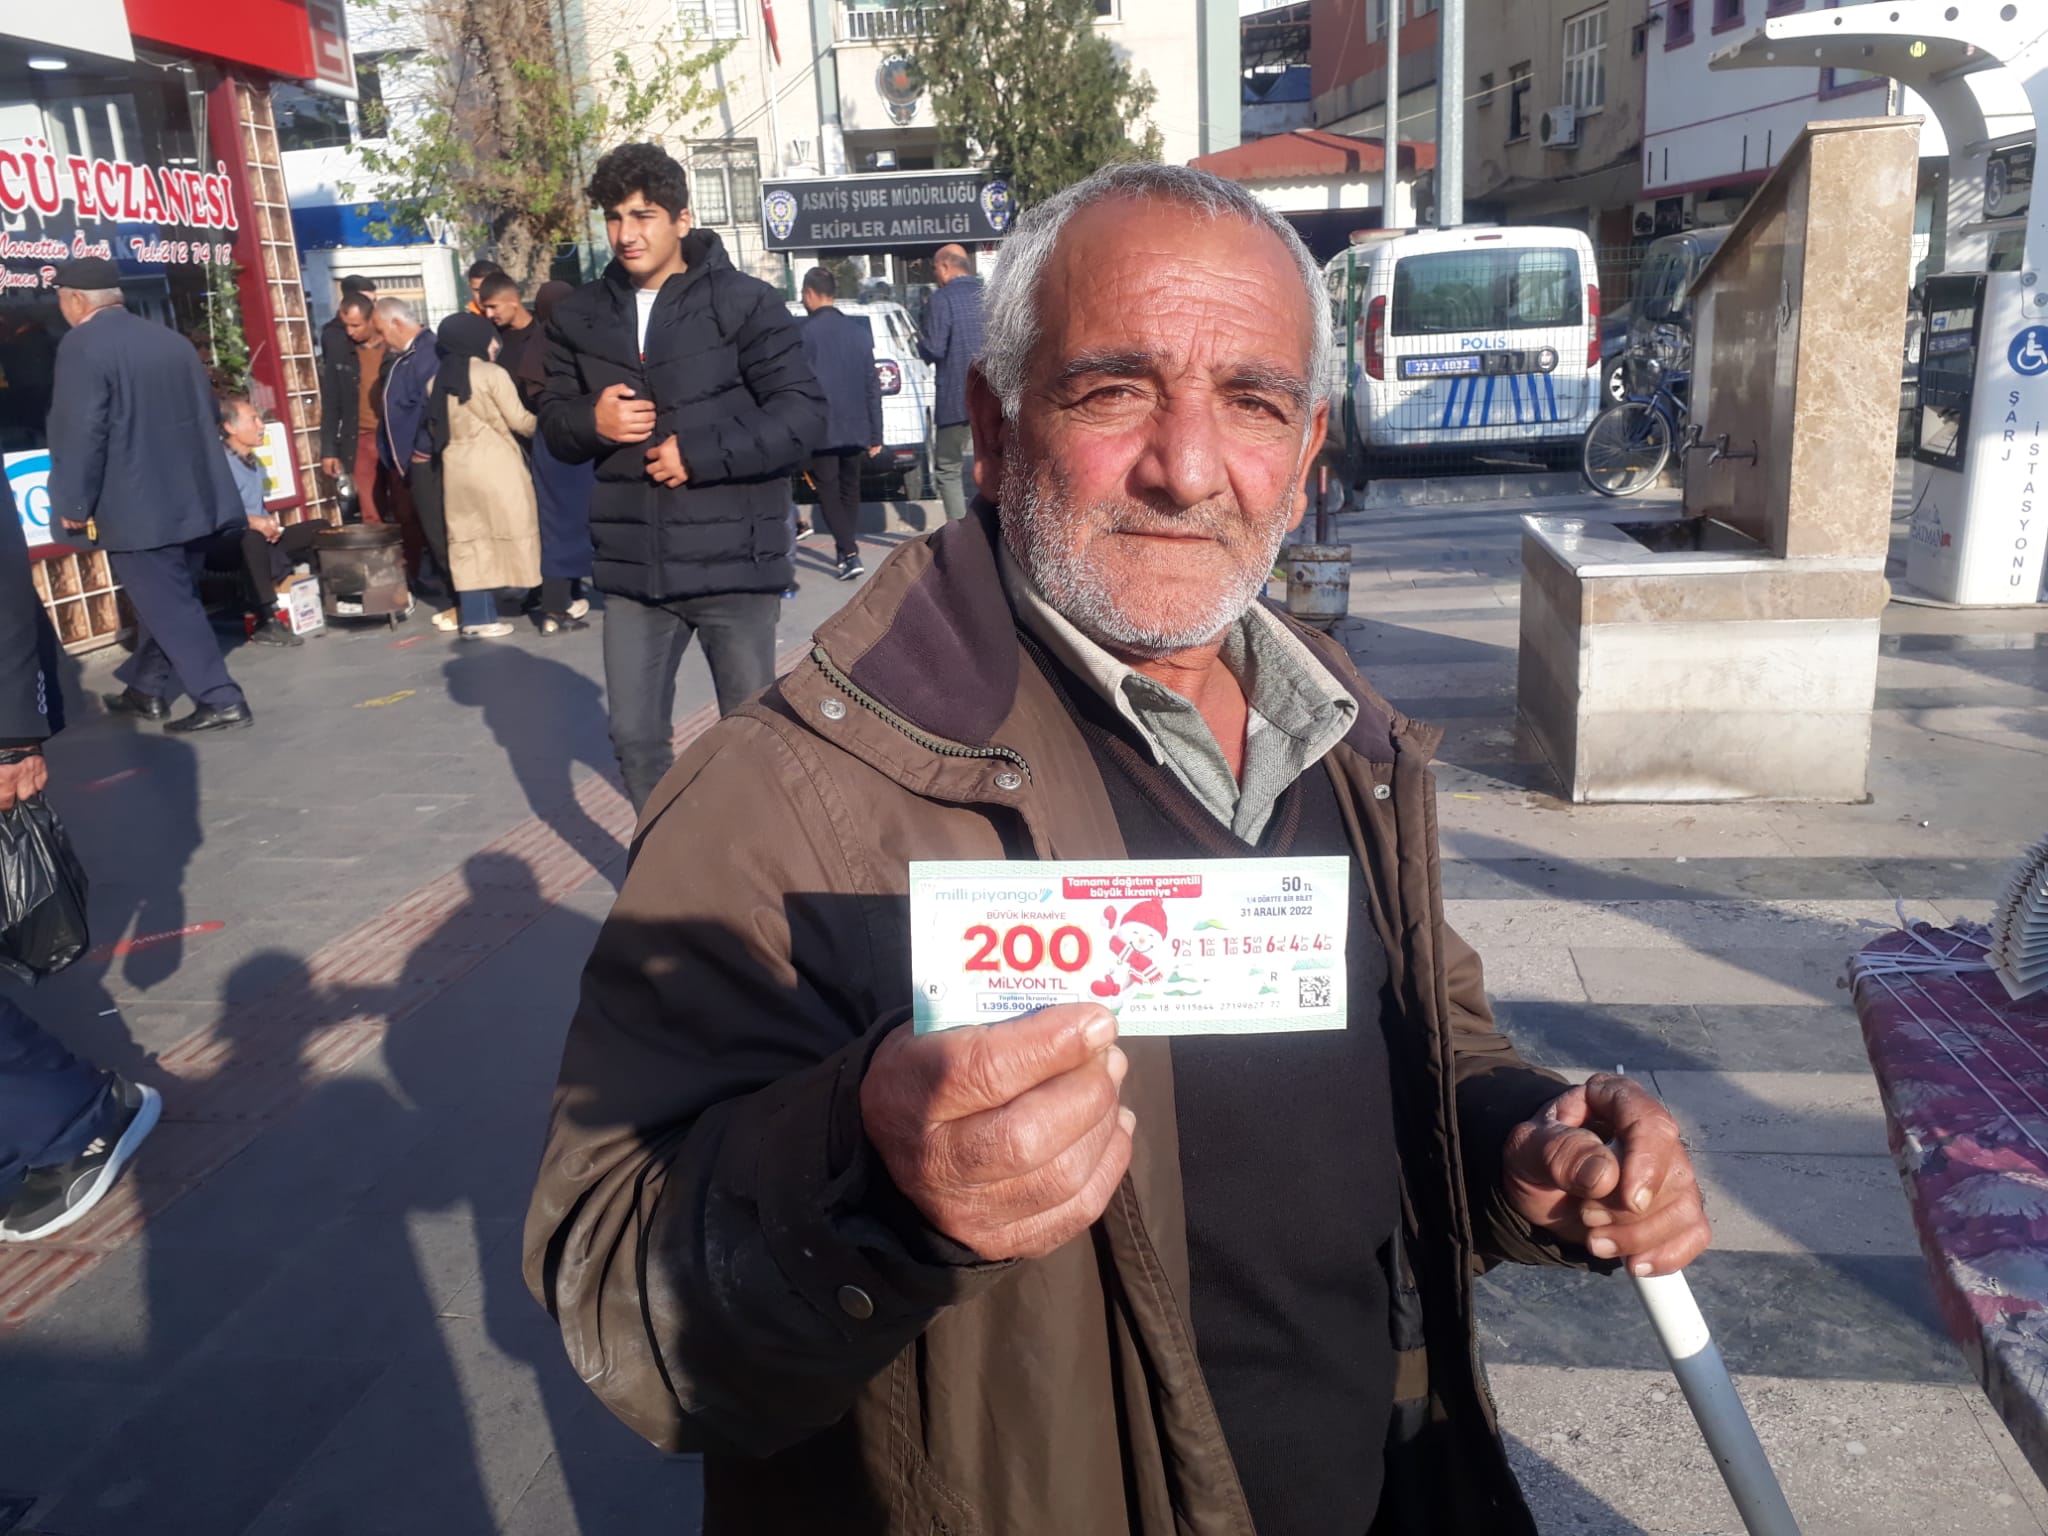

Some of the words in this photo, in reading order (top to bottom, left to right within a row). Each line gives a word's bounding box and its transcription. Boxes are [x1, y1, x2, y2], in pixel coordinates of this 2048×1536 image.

[68, 157, 238, 230] ECZANESİ
[801, 187, 848, 212] ASAYİŞ
[851, 188, 887, 210] ŞUBE
[891, 181, 976, 207] MÜDÜRLÜĞÜ
[811, 220, 884, 239] EKİPLER
[890, 213, 970, 236] AMİRLİĞİ
[2001, 390, 2020, 461] ŞARJ
[2010, 421, 2040, 586] İSTASYONU
[1067, 877, 1110, 887] Tamamı
[1112, 876, 1153, 888] dağıtım
[1155, 875, 1200, 887] garantili
[1282, 876, 1301, 892] 50
[1303, 882, 1312, 891] TL
[935, 889, 968, 901] milli
[972, 889, 1038, 903] piyango
[1090, 887, 1123, 898] büyük
[986, 909, 1019, 920] BÜYÜK
[1021, 909, 1066, 920] İKRAMİYE
[1240, 907, 1251, 917] 31
[1253, 906, 1287, 917] ARALIK
[1290, 905, 1312, 916] 2022
[964, 924, 1091, 973] 200
[989, 976, 1046, 990] MİLYON
[1050, 978, 1067, 990] TL
[1271, 972, 1278, 981] R
[929, 985, 938, 994] R
[982, 1002, 1057, 1011] 1.395.900.0
